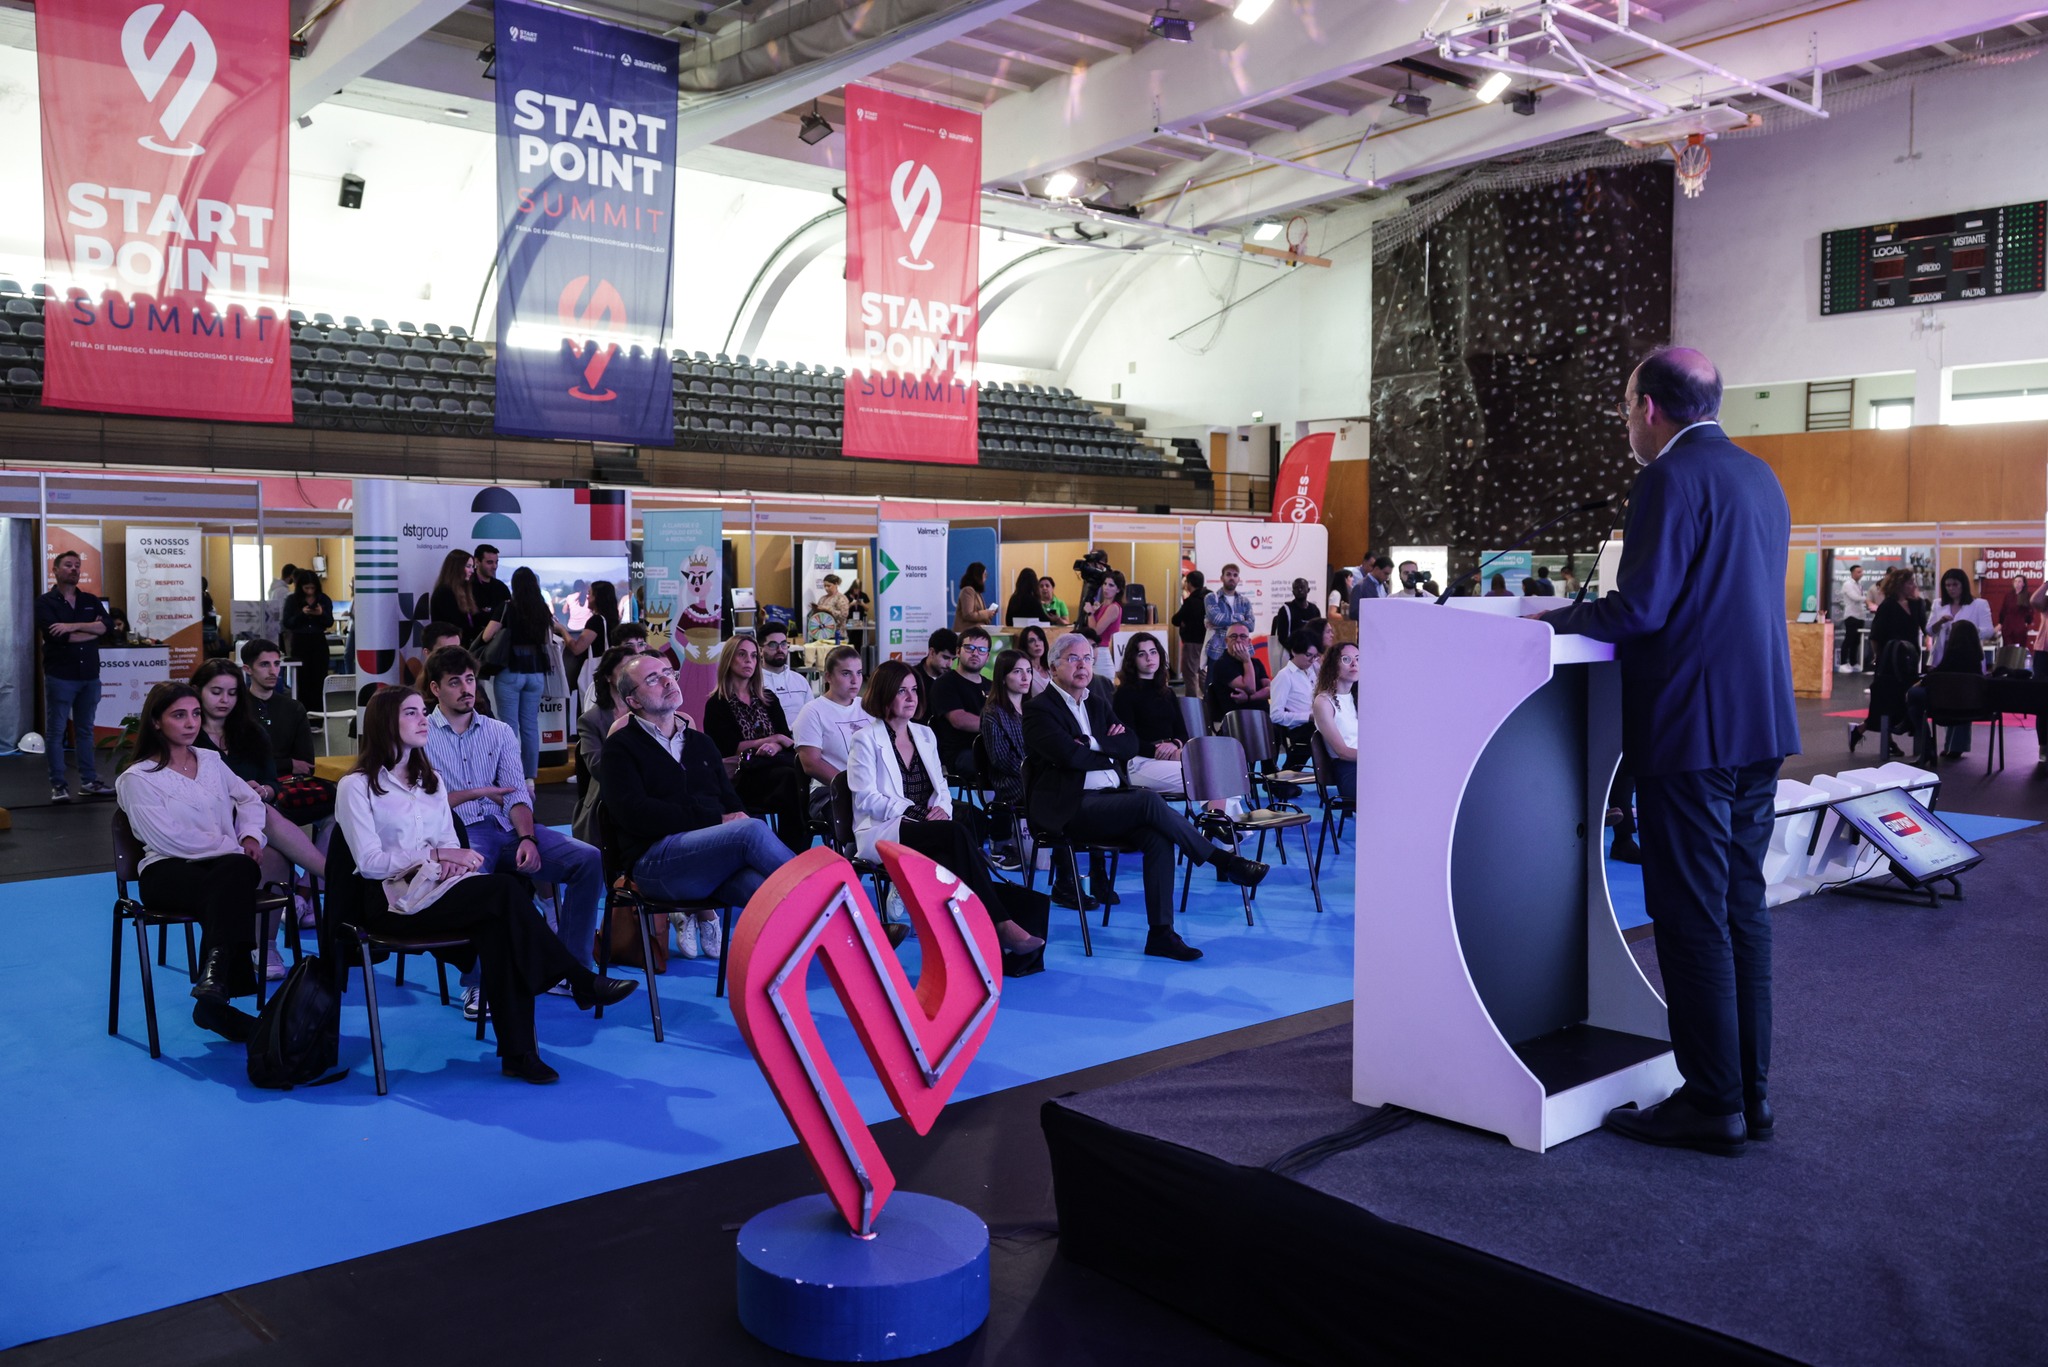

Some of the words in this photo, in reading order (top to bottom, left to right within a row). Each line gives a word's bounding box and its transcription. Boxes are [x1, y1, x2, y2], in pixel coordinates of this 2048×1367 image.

[633, 58, 667, 73] aauminho
[513, 88, 667, 154] START
[518, 133, 663, 196] POINT
[67, 182, 274, 249] START
[517, 187, 664, 234] SUMMIT
[1953, 234, 1986, 247] VISITANTE
[1872, 246, 1905, 258] LOCAL
[74, 234, 270, 294] POINT
[1912, 292, 1942, 304] JOGADOR
[1961, 288, 1986, 298] FALTAS
[1872, 298, 1895, 308] FALTAS
[73, 296, 273, 342] SUMMIT
[861, 291, 972, 337] START
[70, 340, 93, 350] FEIRA
[106, 344, 148, 354] EMPREGO,
[148, 348, 228, 361] EMPREENDEDORISMO
[235, 355, 274, 365] FORMAÇÃO
[864, 330, 969, 372] POINT
[861, 375, 966, 404] SUMMIT
[402, 522, 449, 541] dstgroup
[1986, 550, 2017, 559] Bolsa
[1986, 560, 2000, 569] de
[1986, 570, 1999, 579] da
[2002, 570, 2043, 579] UMinho
[538, 702, 563, 713] ture
